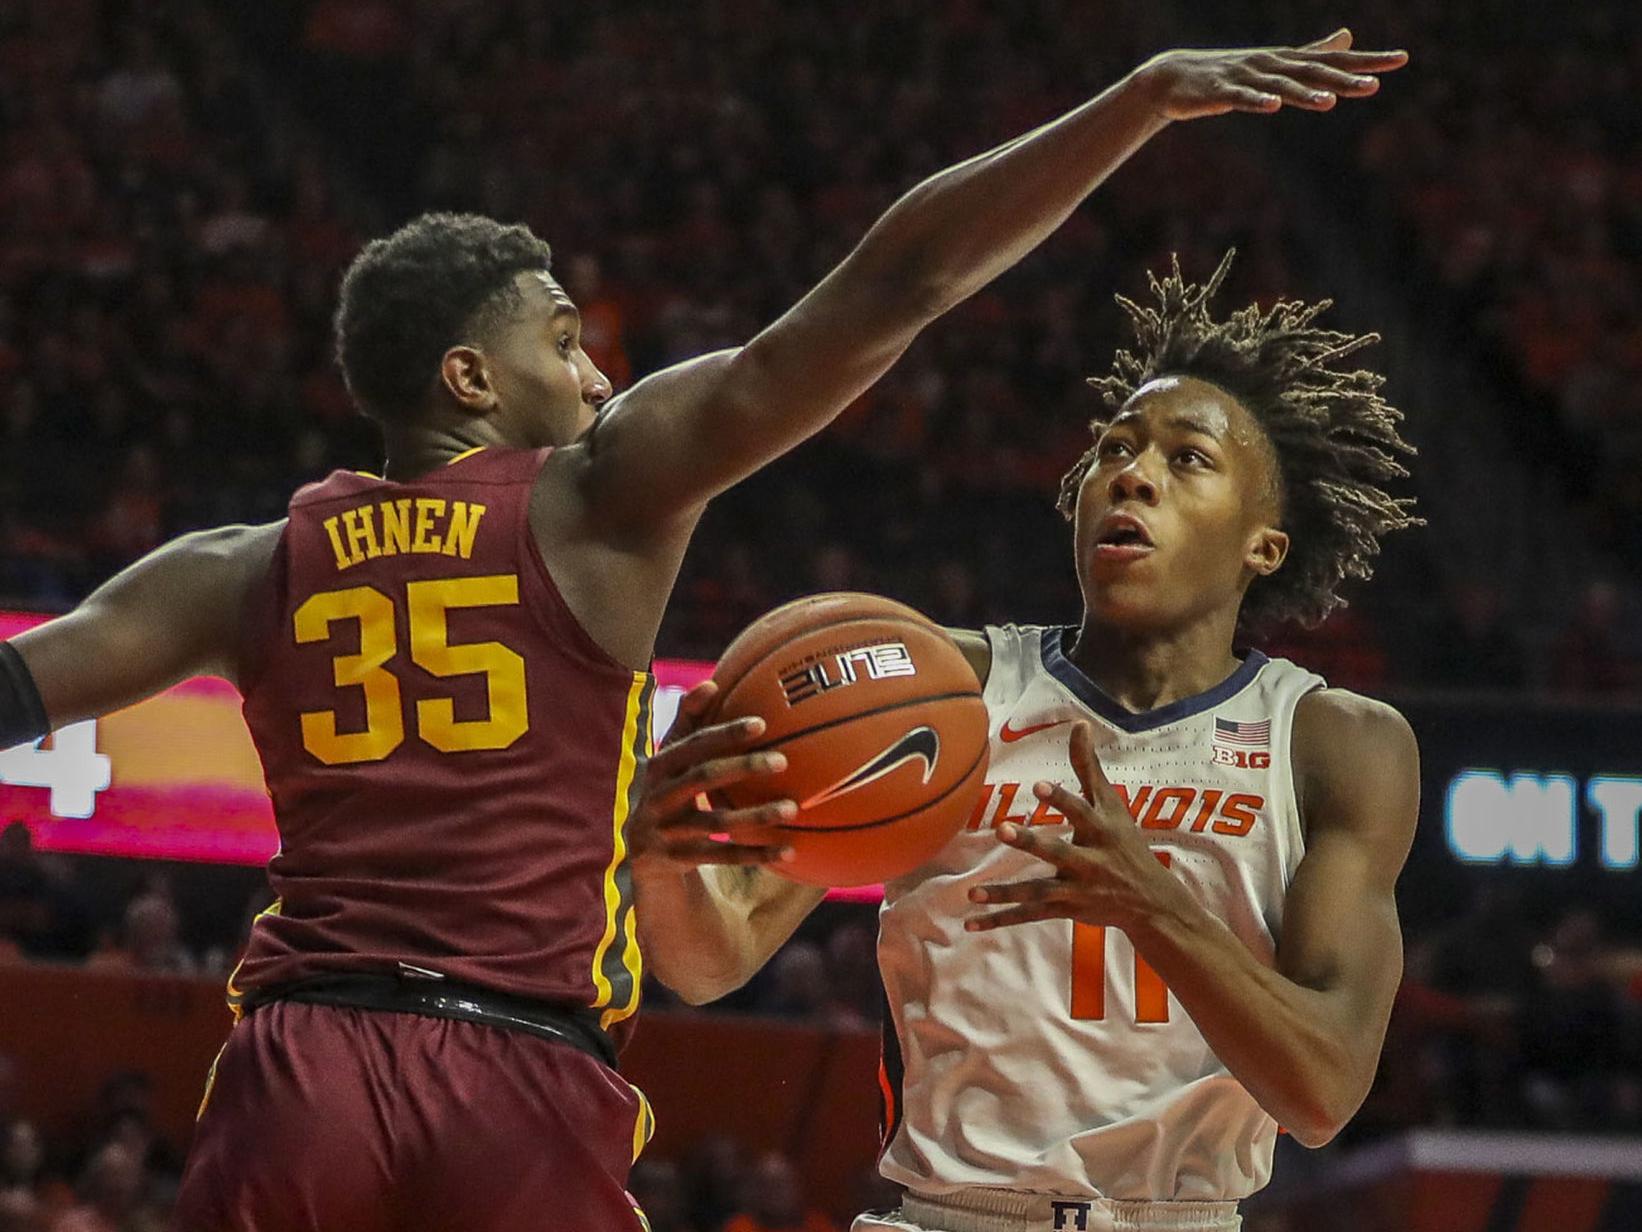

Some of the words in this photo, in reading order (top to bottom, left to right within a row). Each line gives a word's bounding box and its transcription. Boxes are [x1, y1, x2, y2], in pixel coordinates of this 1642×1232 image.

[323, 498, 487, 571] IHNEN
[293, 574, 529, 765] 35
[776, 642, 917, 708] ELITE
[965, 782, 1266, 837] ILLNOIS
